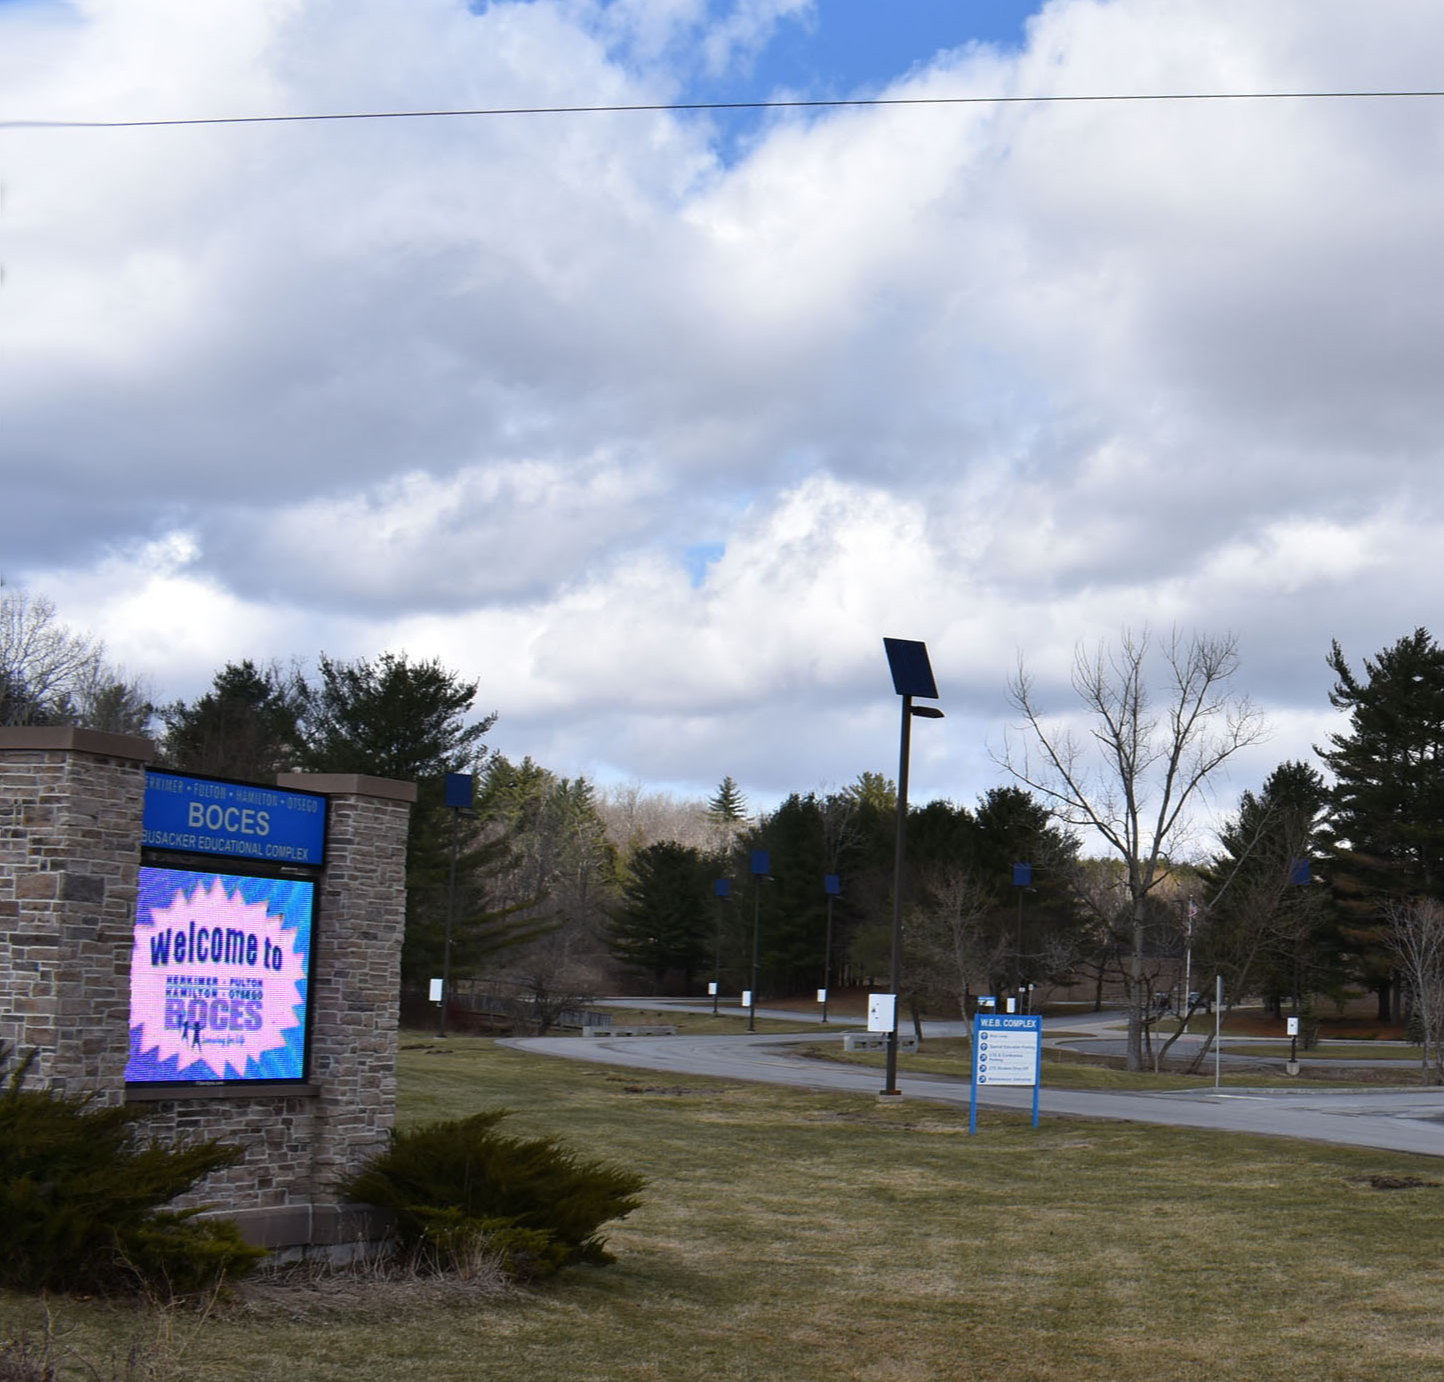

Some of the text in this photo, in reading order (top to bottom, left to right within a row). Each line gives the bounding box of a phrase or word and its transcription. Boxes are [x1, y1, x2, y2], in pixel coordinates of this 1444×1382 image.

[194, 782, 226, 800] FULTON
[236, 789, 278, 807] HAMILTON
[287, 796, 318, 813] OTSEGO
[188, 801, 270, 837] BOCES
[142, 829, 309, 862] BUSACKER EDUCATIONAL COMPLEX
[264, 936, 283, 971] to
[165, 987, 263, 1000] HAMILTON OTSEGO
[166, 975, 263, 988] HERKIMER FULTON
[164, 998, 263, 1031] BOCES
[980, 1018, 1037, 1028] W.E.B. COMPLEX
